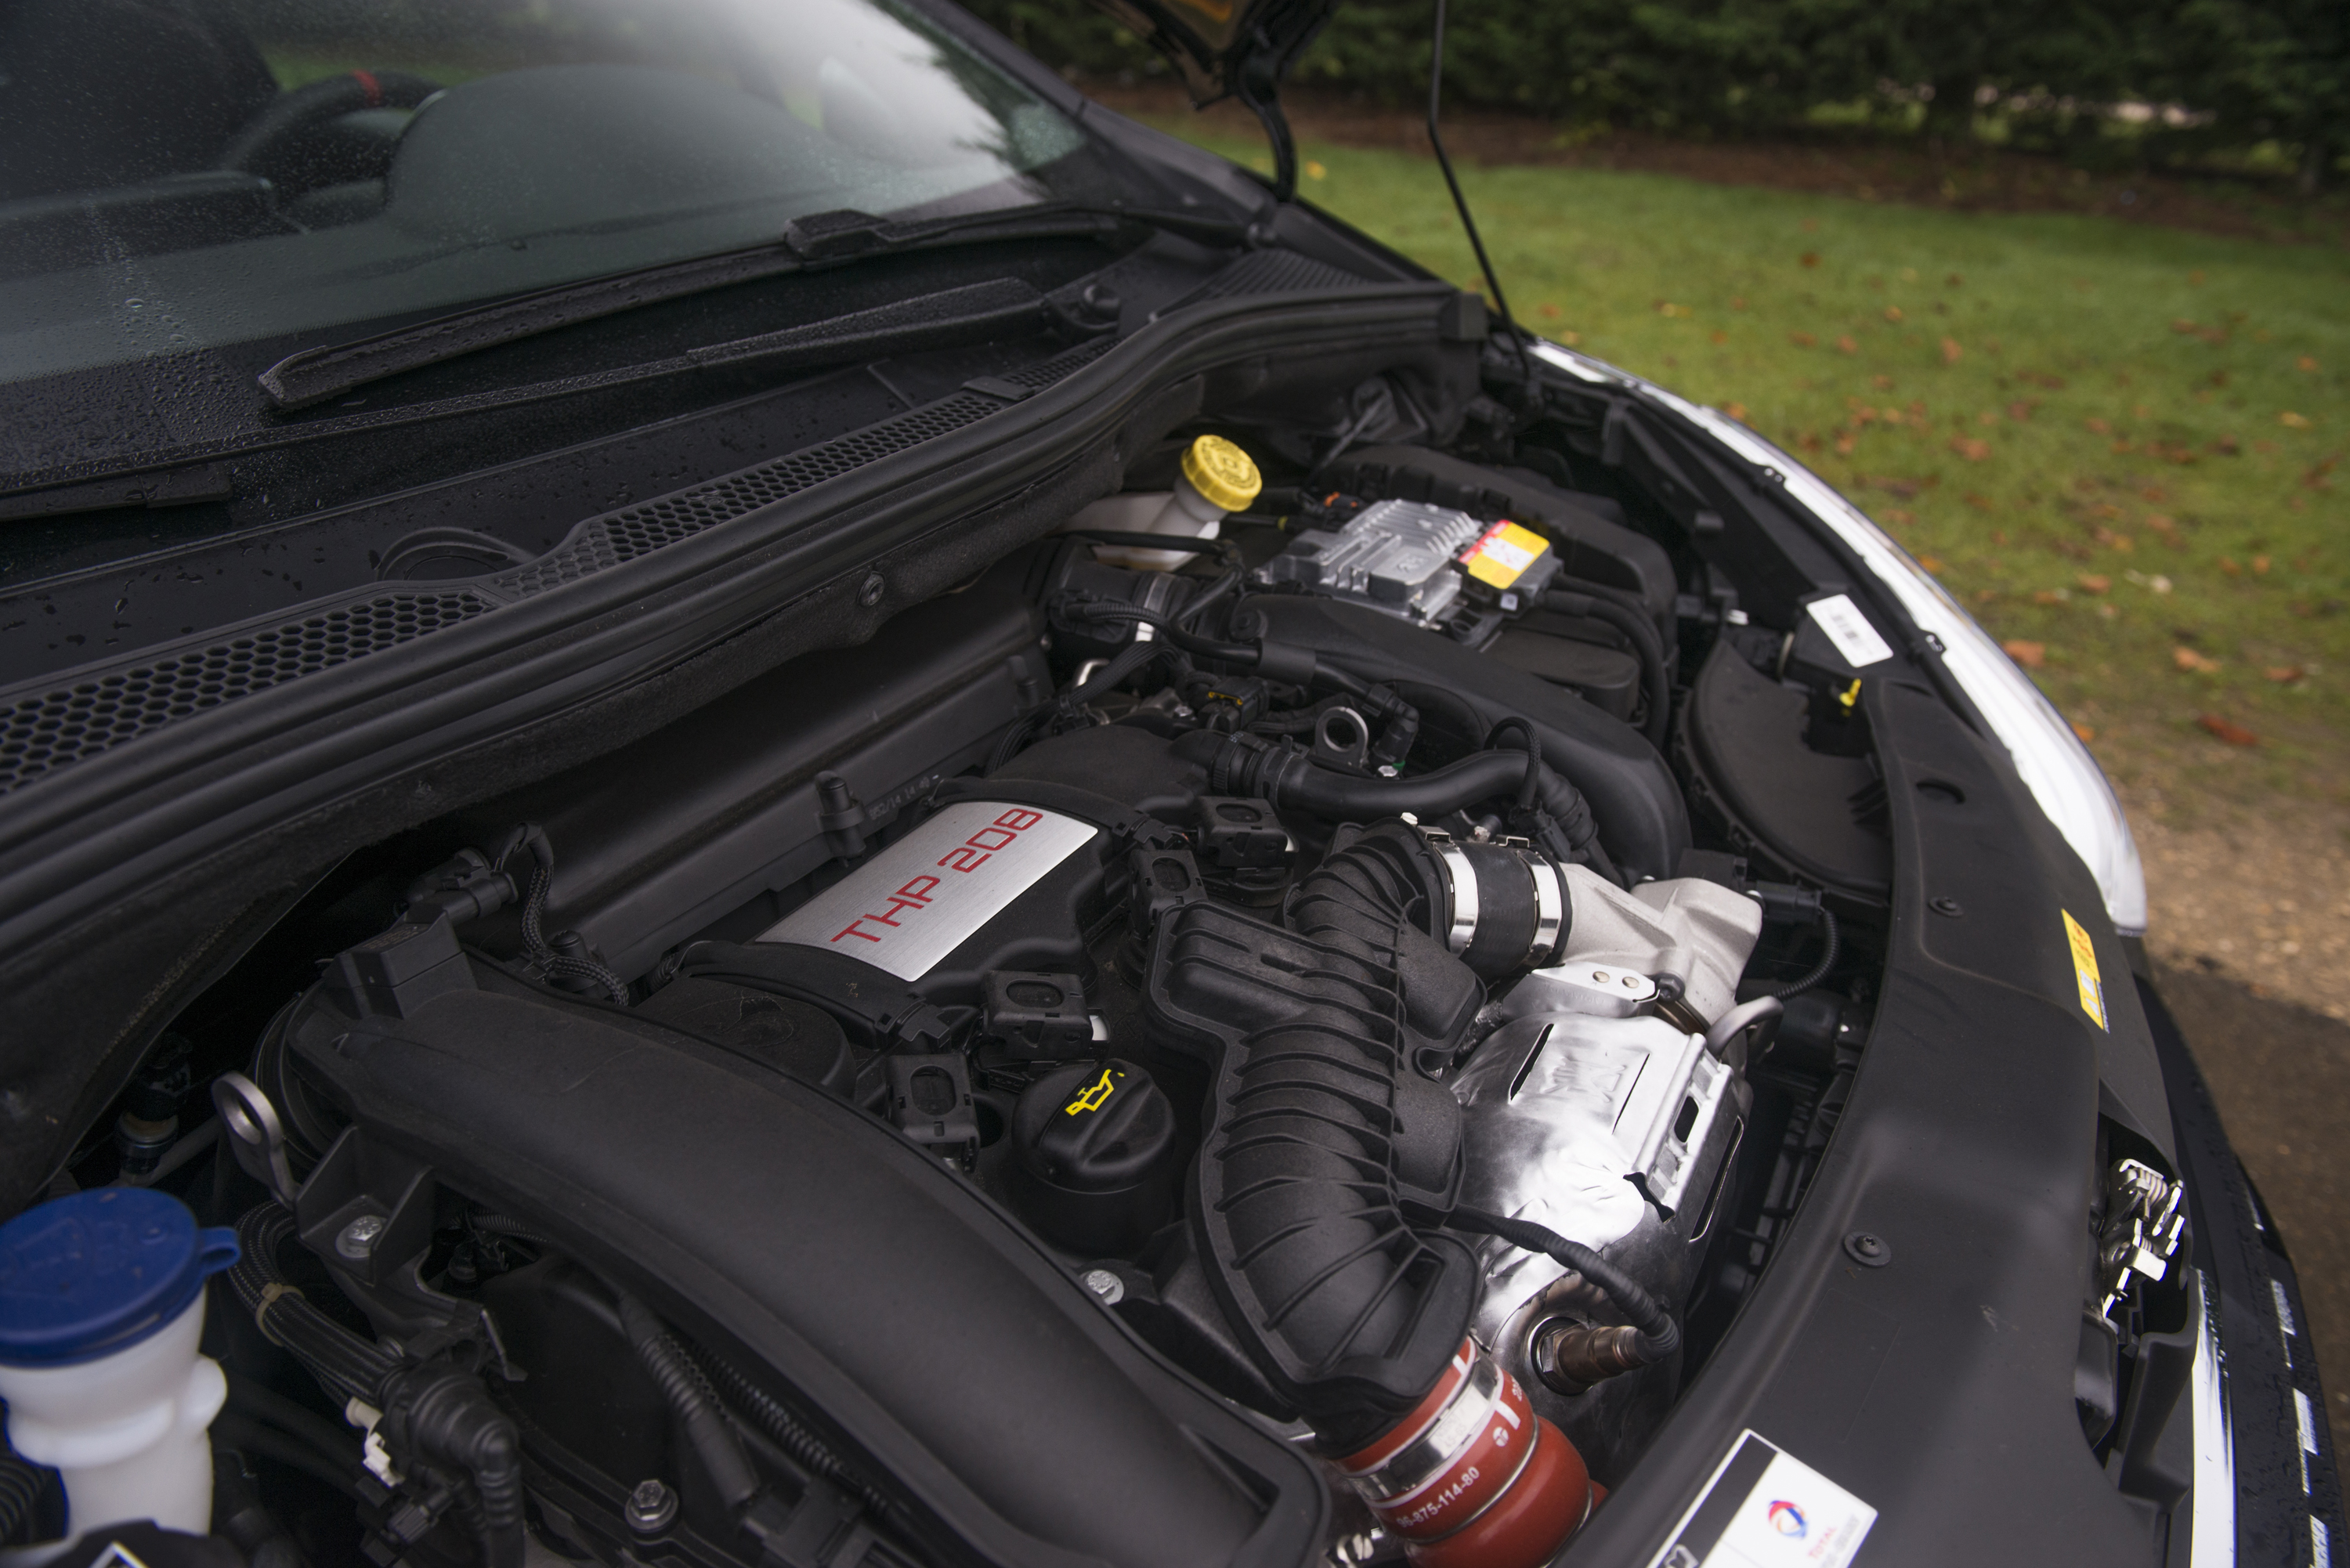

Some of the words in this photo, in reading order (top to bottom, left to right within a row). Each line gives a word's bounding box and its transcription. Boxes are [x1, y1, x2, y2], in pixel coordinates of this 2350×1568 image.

[830, 875, 941, 943] THP
[937, 808, 1043, 873] 208
[1396, 1465, 1480, 1528] 96-875-114-80
[1808, 1526, 1838, 1560] TOTAL
